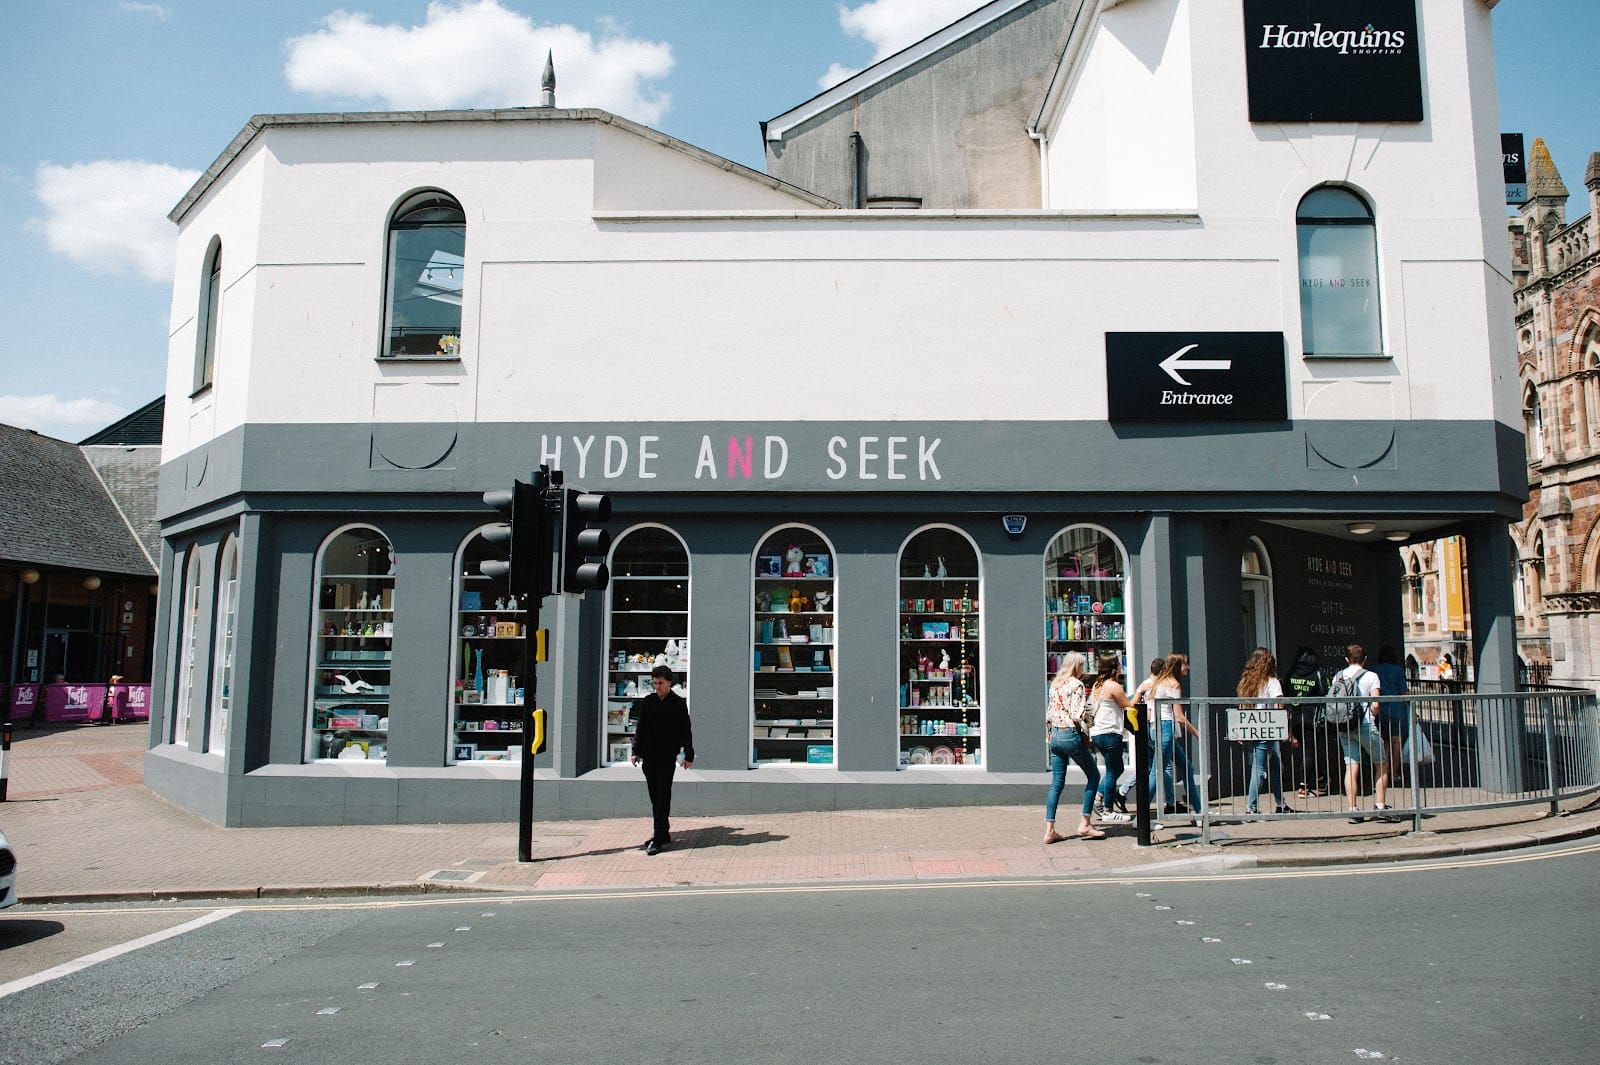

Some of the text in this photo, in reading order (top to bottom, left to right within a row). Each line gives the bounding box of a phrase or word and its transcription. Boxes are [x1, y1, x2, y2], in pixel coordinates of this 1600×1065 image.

[1259, 22, 1405, 54] Harlequins
[1302, 278, 1371, 288] HYDE AND SEEK
[1160, 390, 1234, 405] Entrance
[539, 434, 942, 480] HYDE AND SEEK
[1307, 555, 1323, 572] HYDE
[1321, 600, 1344, 616] GIFTS
[1323, 645, 1346, 657] BOOKS
[1239, 711, 1276, 724] PAUL
[1231, 726, 1285, 739] STREET
